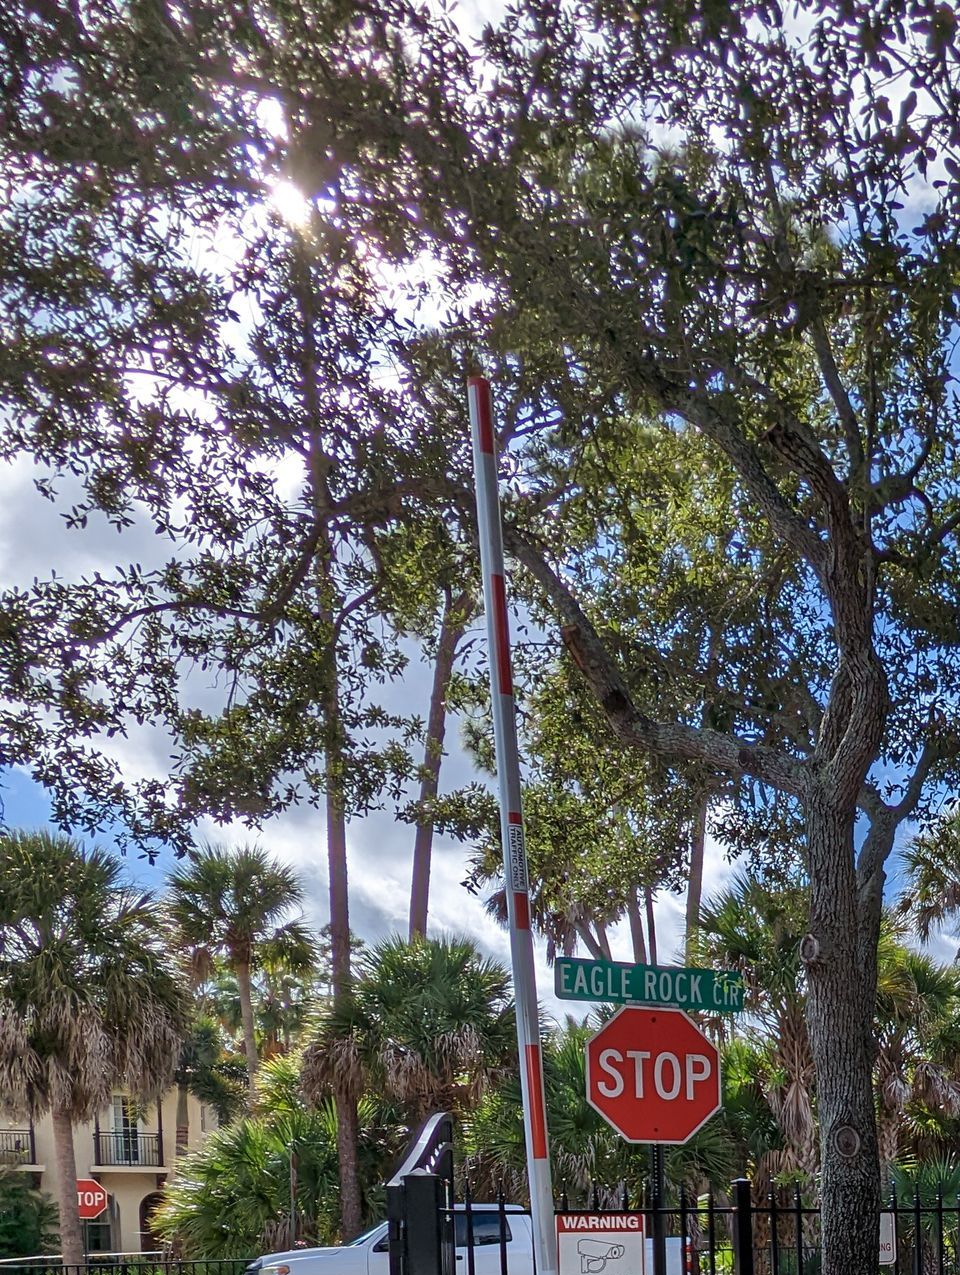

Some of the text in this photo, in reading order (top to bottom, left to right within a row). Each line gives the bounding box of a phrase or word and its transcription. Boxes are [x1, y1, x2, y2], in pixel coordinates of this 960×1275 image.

[510, 827, 520, 889] TRAFFIC ONLY
[516, 829, 525, 886] AUTOMOTIVE
[560, 963, 739, 1006] EAGLE ROCK CIR
[597, 1048, 711, 1101] STOP
[77, 1191, 104, 1207] TOP
[561, 1216, 639, 1229] WARNING
